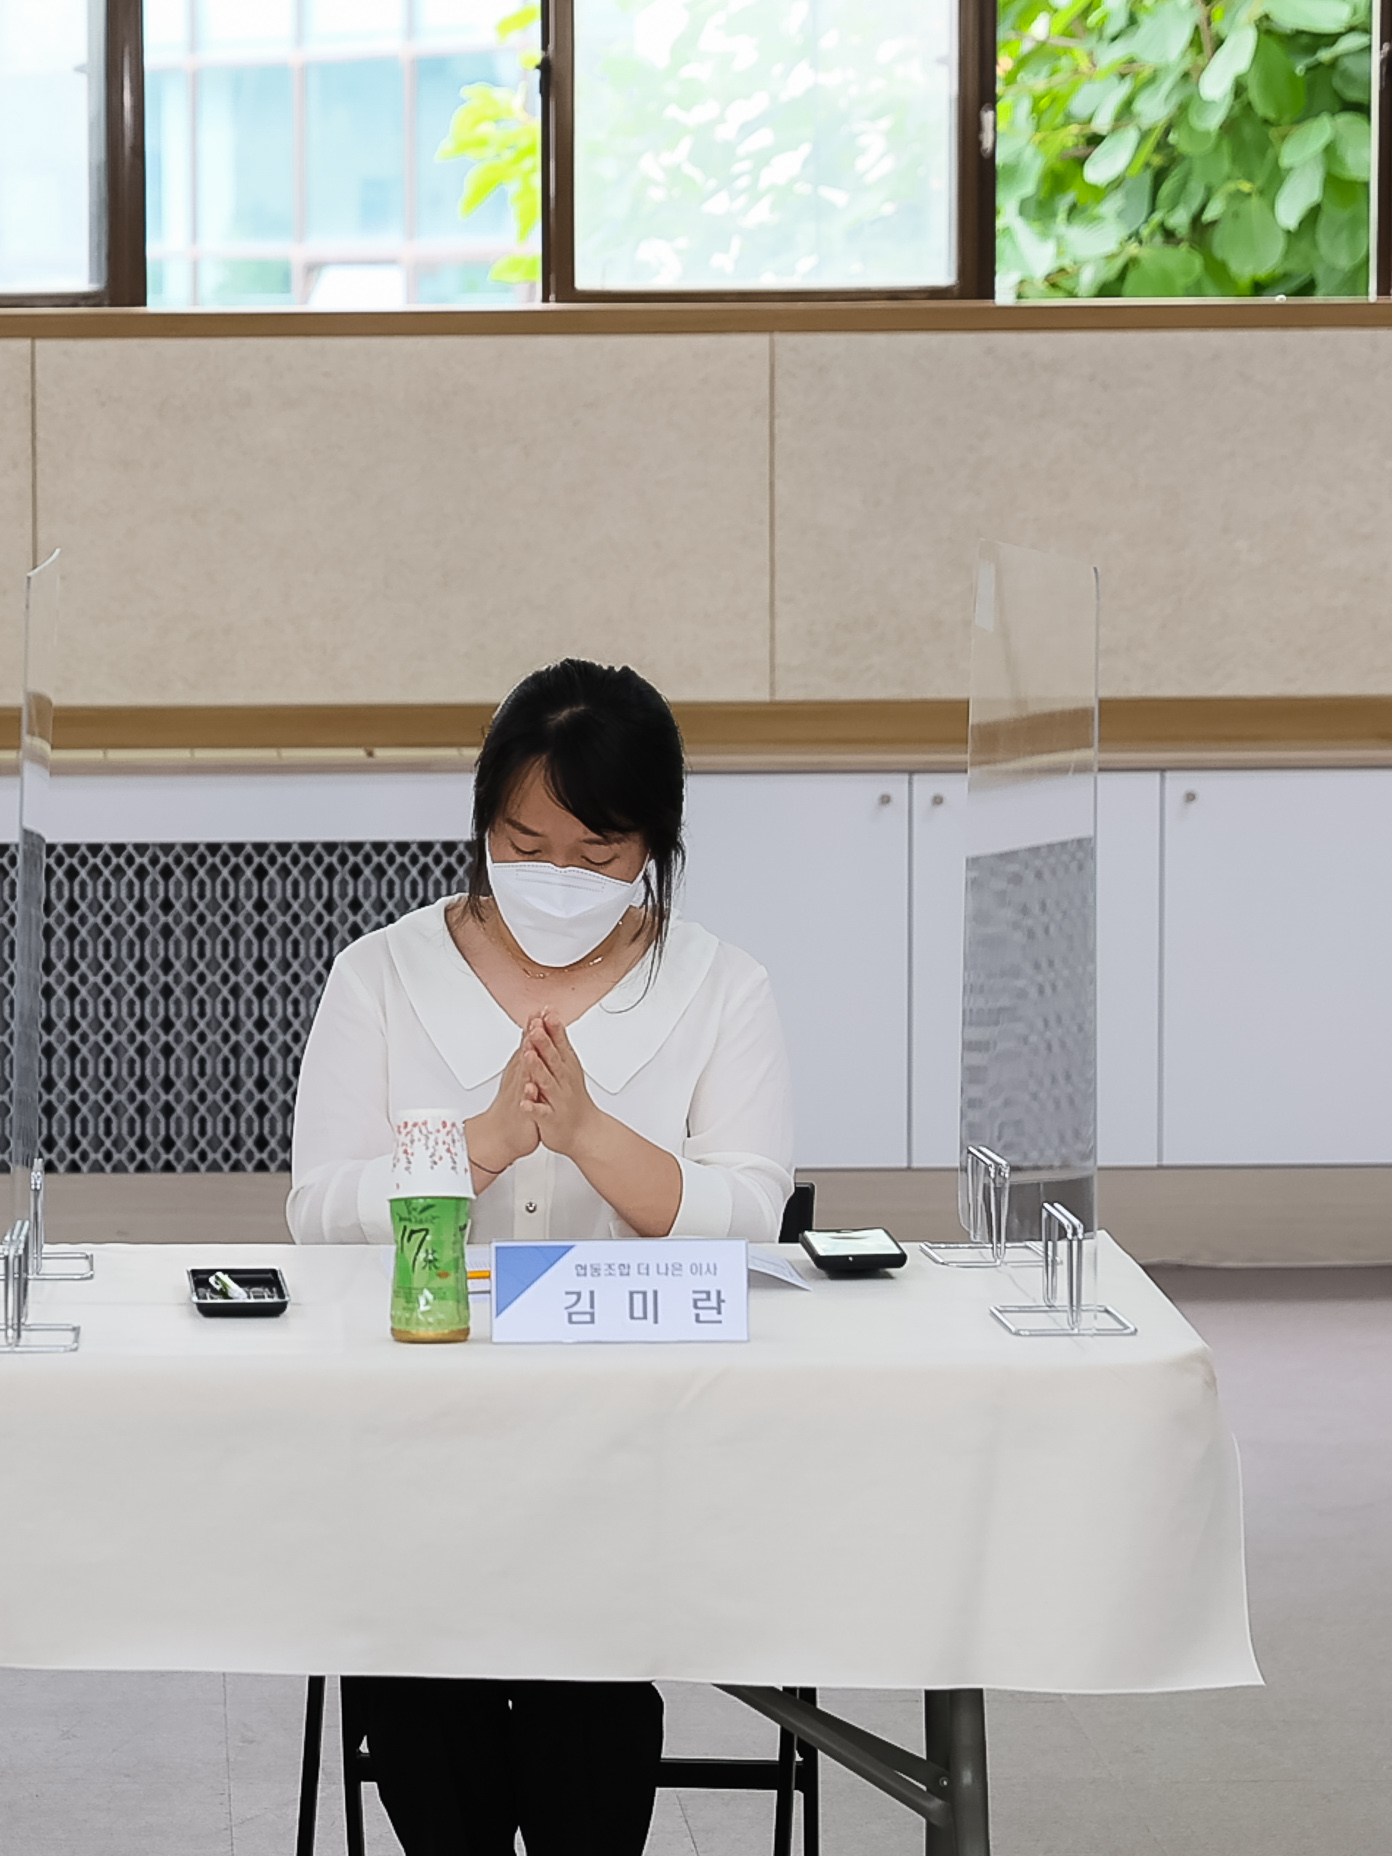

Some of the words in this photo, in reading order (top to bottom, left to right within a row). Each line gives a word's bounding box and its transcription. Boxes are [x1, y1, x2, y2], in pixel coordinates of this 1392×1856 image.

[400, 1225, 429, 1273] 17
[574, 1262, 631, 1278] 협동조합
[636, 1262, 651, 1277] 더
[656, 1262, 683, 1277] 나은
[689, 1262, 718, 1277] 이사
